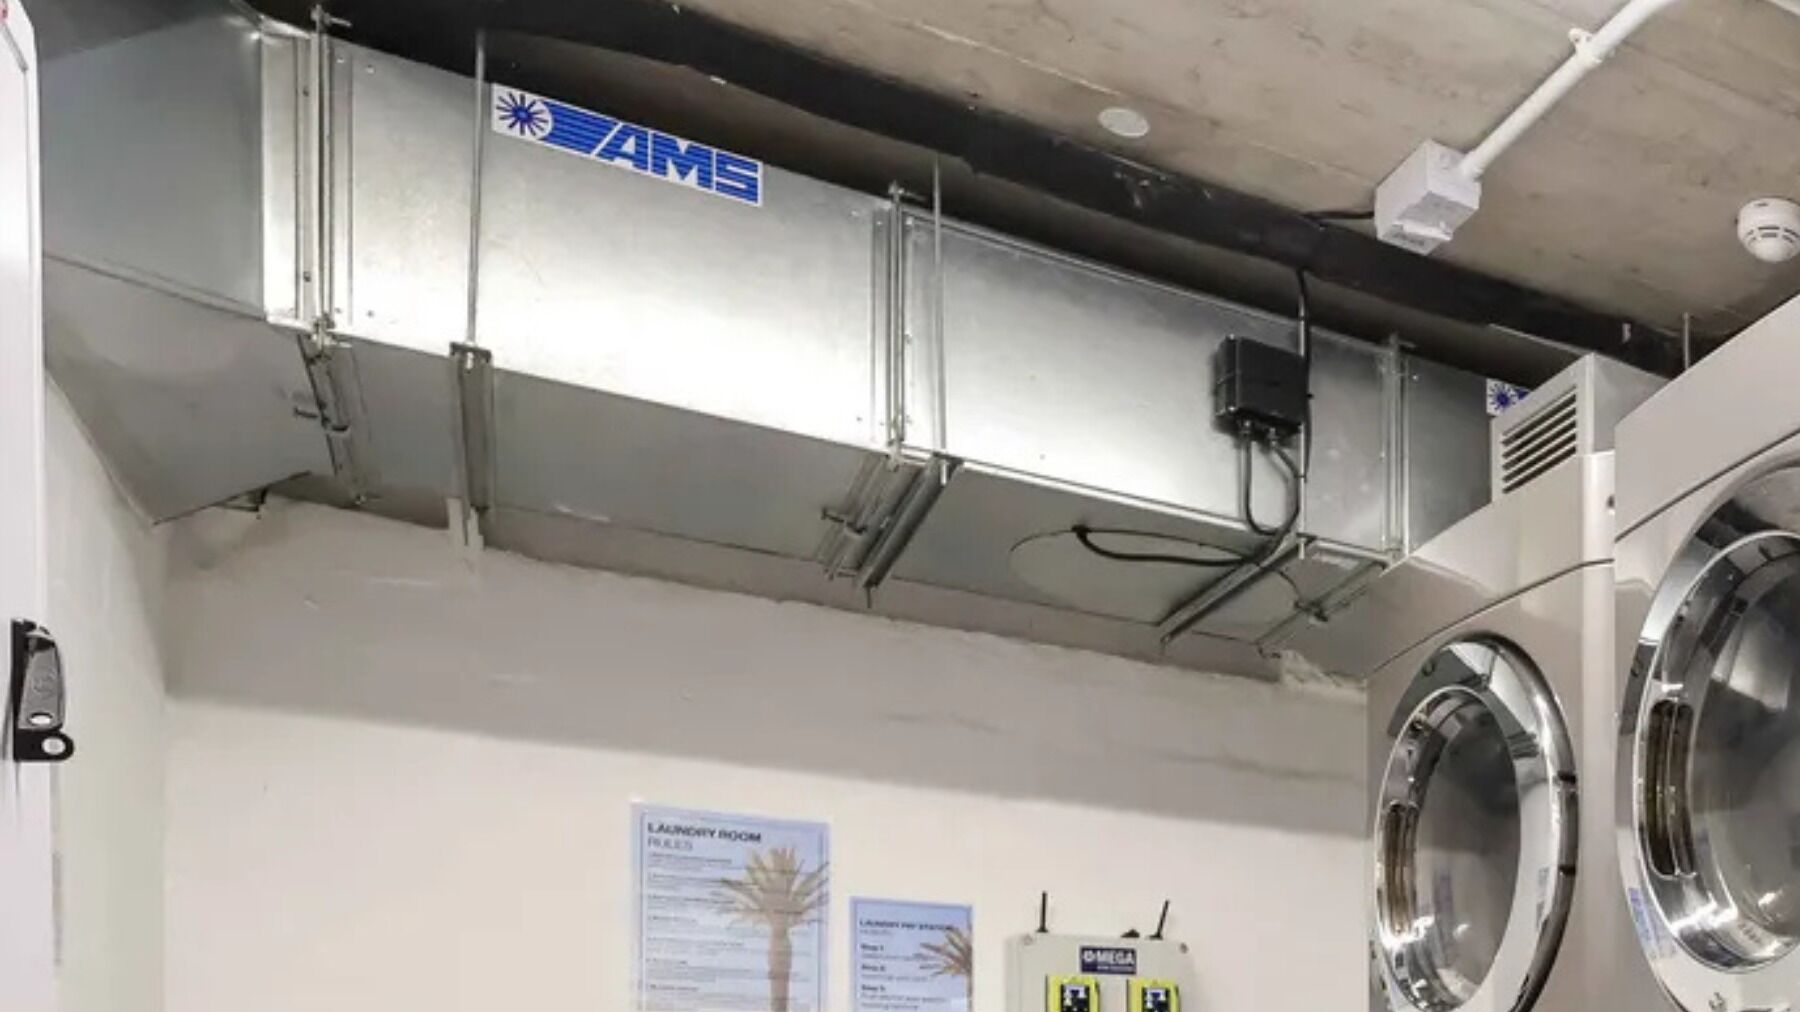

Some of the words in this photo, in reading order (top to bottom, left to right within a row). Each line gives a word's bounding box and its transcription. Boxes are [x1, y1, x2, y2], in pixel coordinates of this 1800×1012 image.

[597, 122, 759, 204] AMS
[647, 821, 717, 838] LAUNDRY
[718, 829, 762, 843] ROOM
[647, 835, 693, 851] RULES
[859, 918, 900, 929] LAUNDRY
[1097, 950, 1135, 966] MEGA
